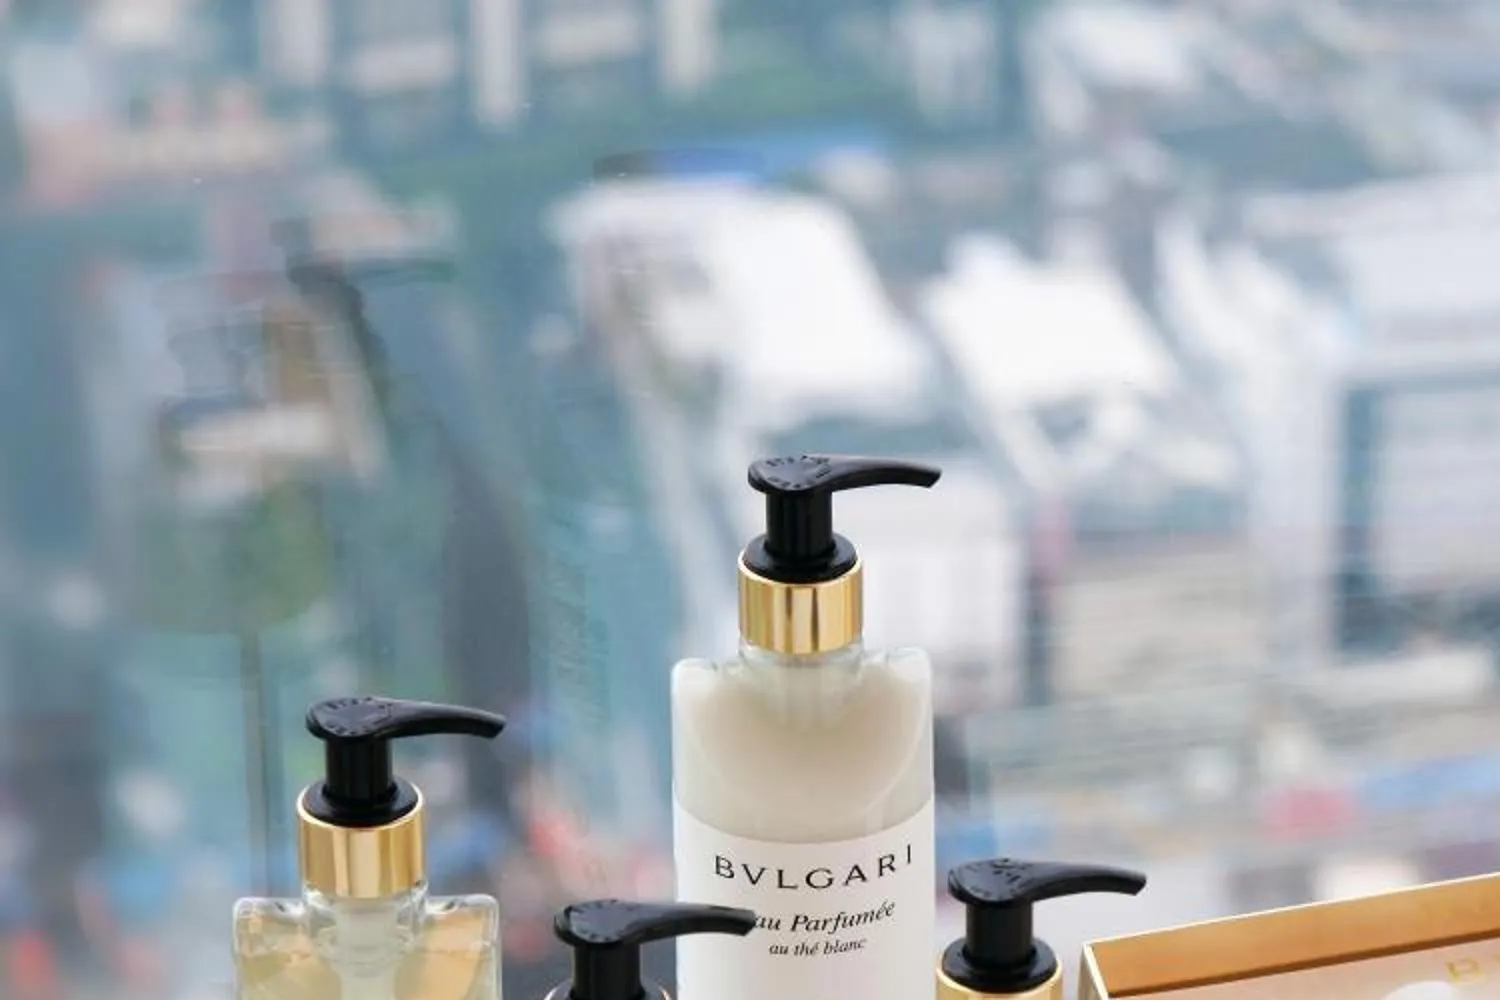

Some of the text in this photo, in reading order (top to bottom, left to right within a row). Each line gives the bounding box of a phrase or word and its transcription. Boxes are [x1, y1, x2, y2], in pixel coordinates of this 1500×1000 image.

[714, 844, 912, 890] BVLGARI
[753, 899, 897, 935] au Parfumée
[768, 938, 868, 957] au thé blanc
